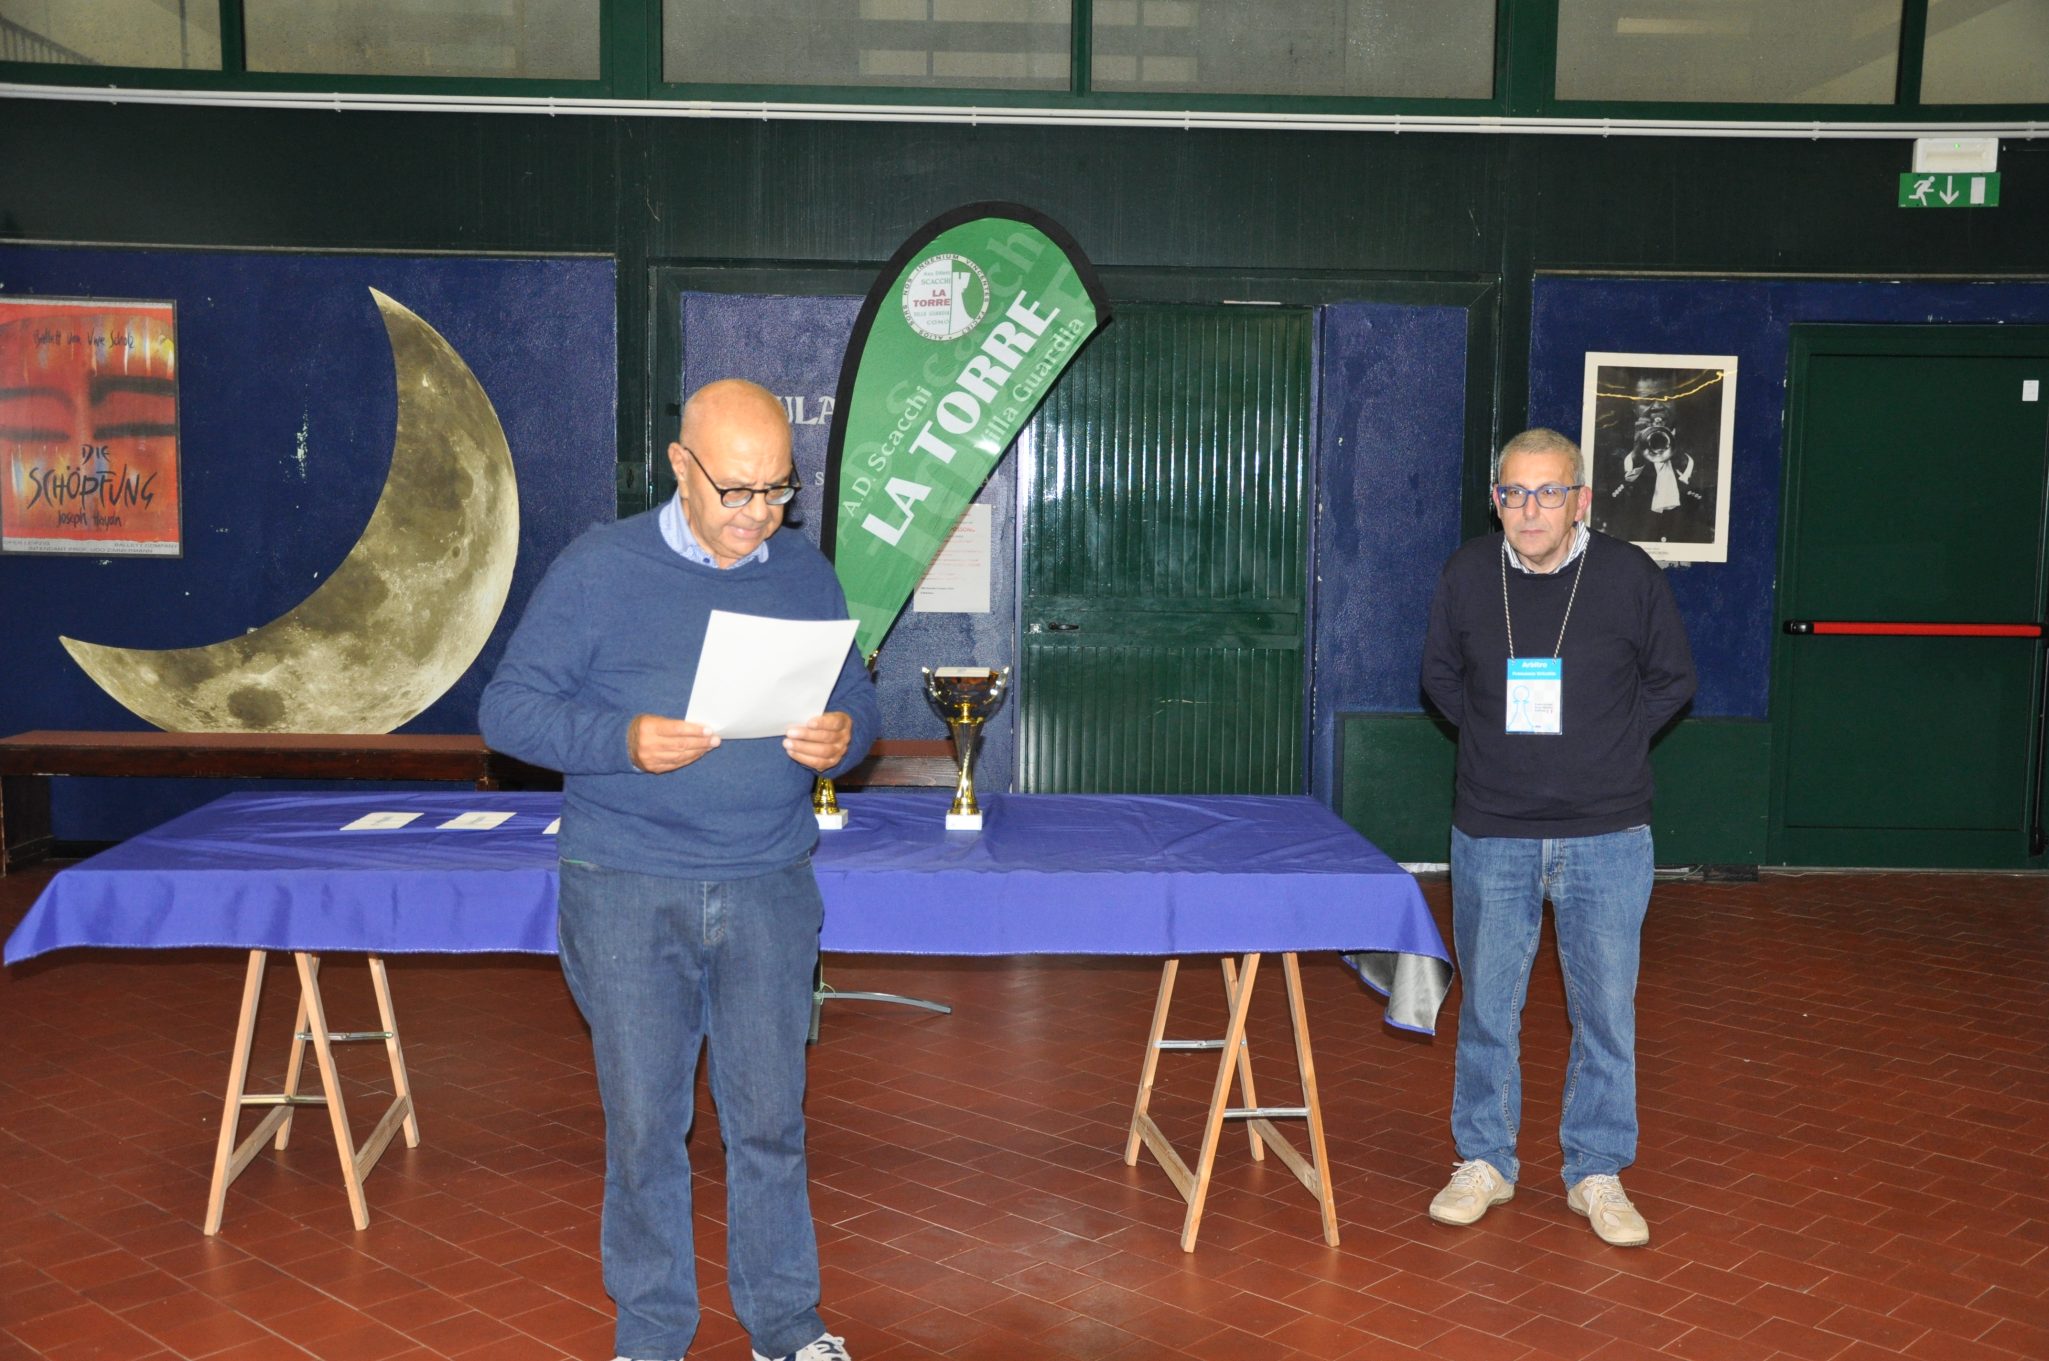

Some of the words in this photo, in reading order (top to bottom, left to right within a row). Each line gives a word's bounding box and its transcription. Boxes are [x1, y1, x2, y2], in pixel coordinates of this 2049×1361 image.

[903, 278, 912, 296] NOS
[916, 254, 959, 272] INGENIUM
[966, 259, 989, 303] VINCENTES
[921, 277, 951, 285] SCACCHI
[913, 299, 951, 307] TORRE
[932, 289, 946, 297] LA
[1012, 318, 1085, 402] Guardia
[861, 476, 932, 547] LA
[908, 289, 1060, 464] TORRE
[82, 444, 111, 465] DIE
[842, 476, 877, 517] A.D.
[867, 385, 933, 472] Scacchi
[27, 464, 158, 510] SCHÖPFUNG
[57, 510, 88, 528] Joseph
[93, 509, 122, 530] Haydn
[1522, 661, 1548, 669] Arbitro
